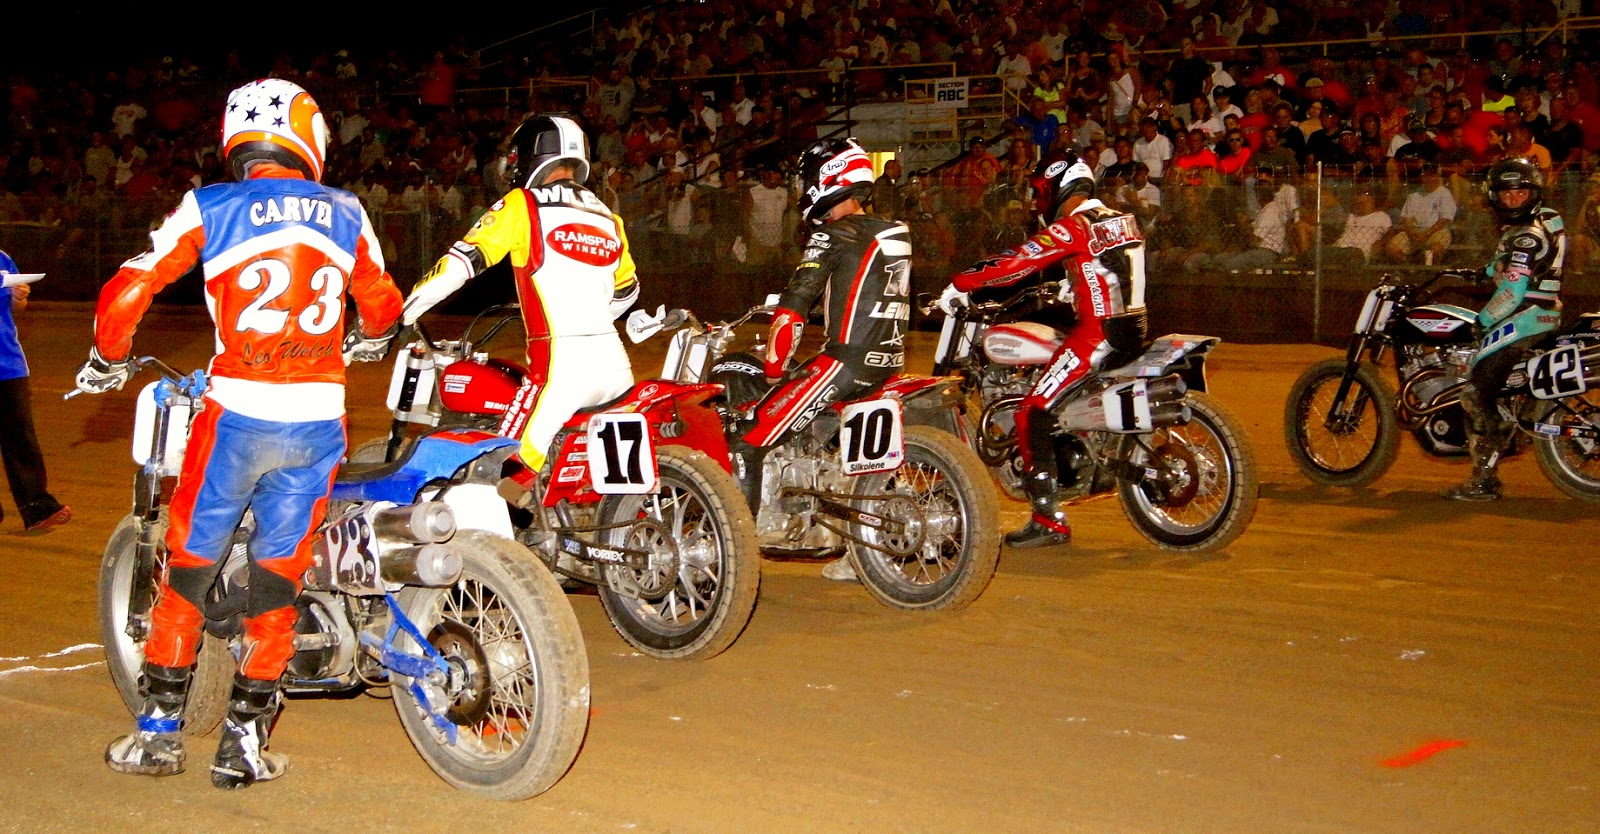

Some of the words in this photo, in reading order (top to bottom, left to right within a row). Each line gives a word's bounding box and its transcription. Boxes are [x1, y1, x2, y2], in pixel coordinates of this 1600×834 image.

[937, 89, 965, 102] ABC
[826, 162, 844, 172] Arai
[1049, 162, 1066, 175] Arai
[554, 230, 617, 252] RAMSPUR
[562, 243, 611, 259] WINERY
[235, 257, 345, 336] 23
[242, 342, 271, 366] Leo
[279, 338, 334, 360] Welch
[1532, 348, 1581, 396] 42
[1116, 384, 1141, 431] 1
[844, 408, 893, 463] 10
[597, 421, 645, 485] 17
[850, 462, 885, 473] Silkolene
